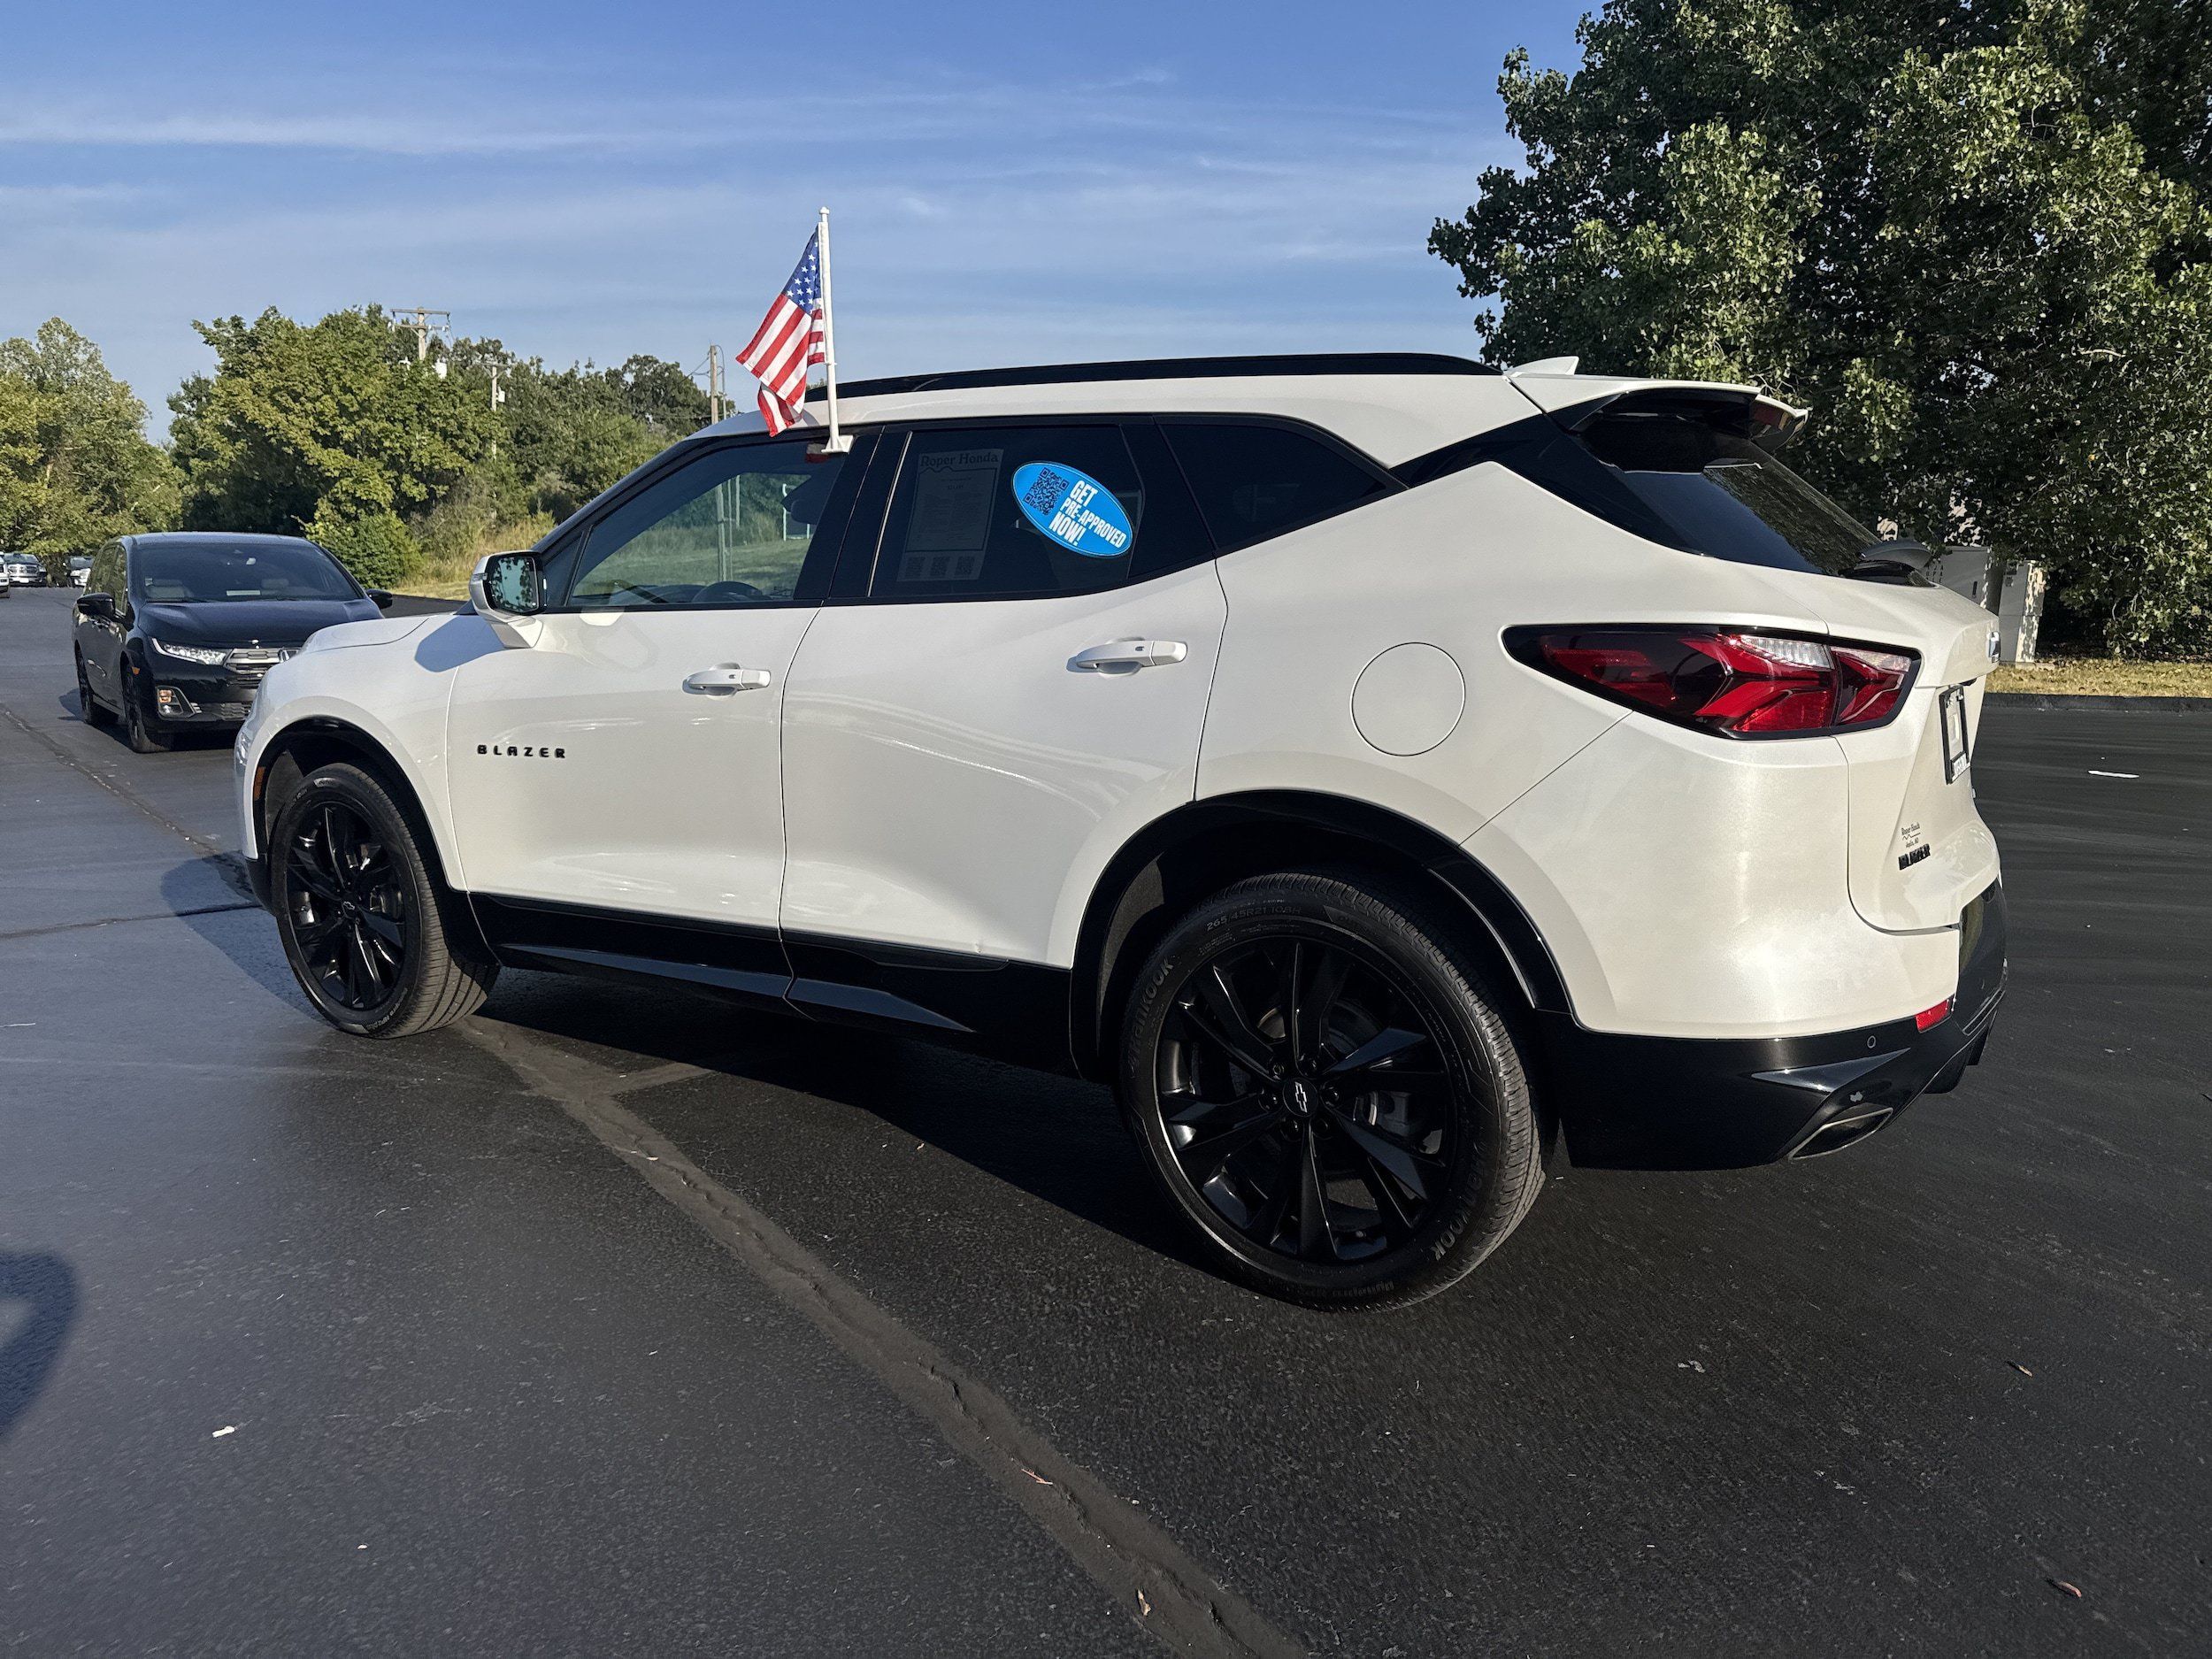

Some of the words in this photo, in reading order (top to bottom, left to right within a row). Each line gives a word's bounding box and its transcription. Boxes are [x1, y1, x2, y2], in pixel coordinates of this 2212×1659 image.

[920, 455, 956, 467] Roper
[958, 452, 999, 465] Honda
[1069, 480, 1098, 507] GET
[1048, 511, 1087, 547] NOW!
[1059, 496, 1127, 549] PRE-APPROVED
[477, 744, 565, 758] BLAZER
